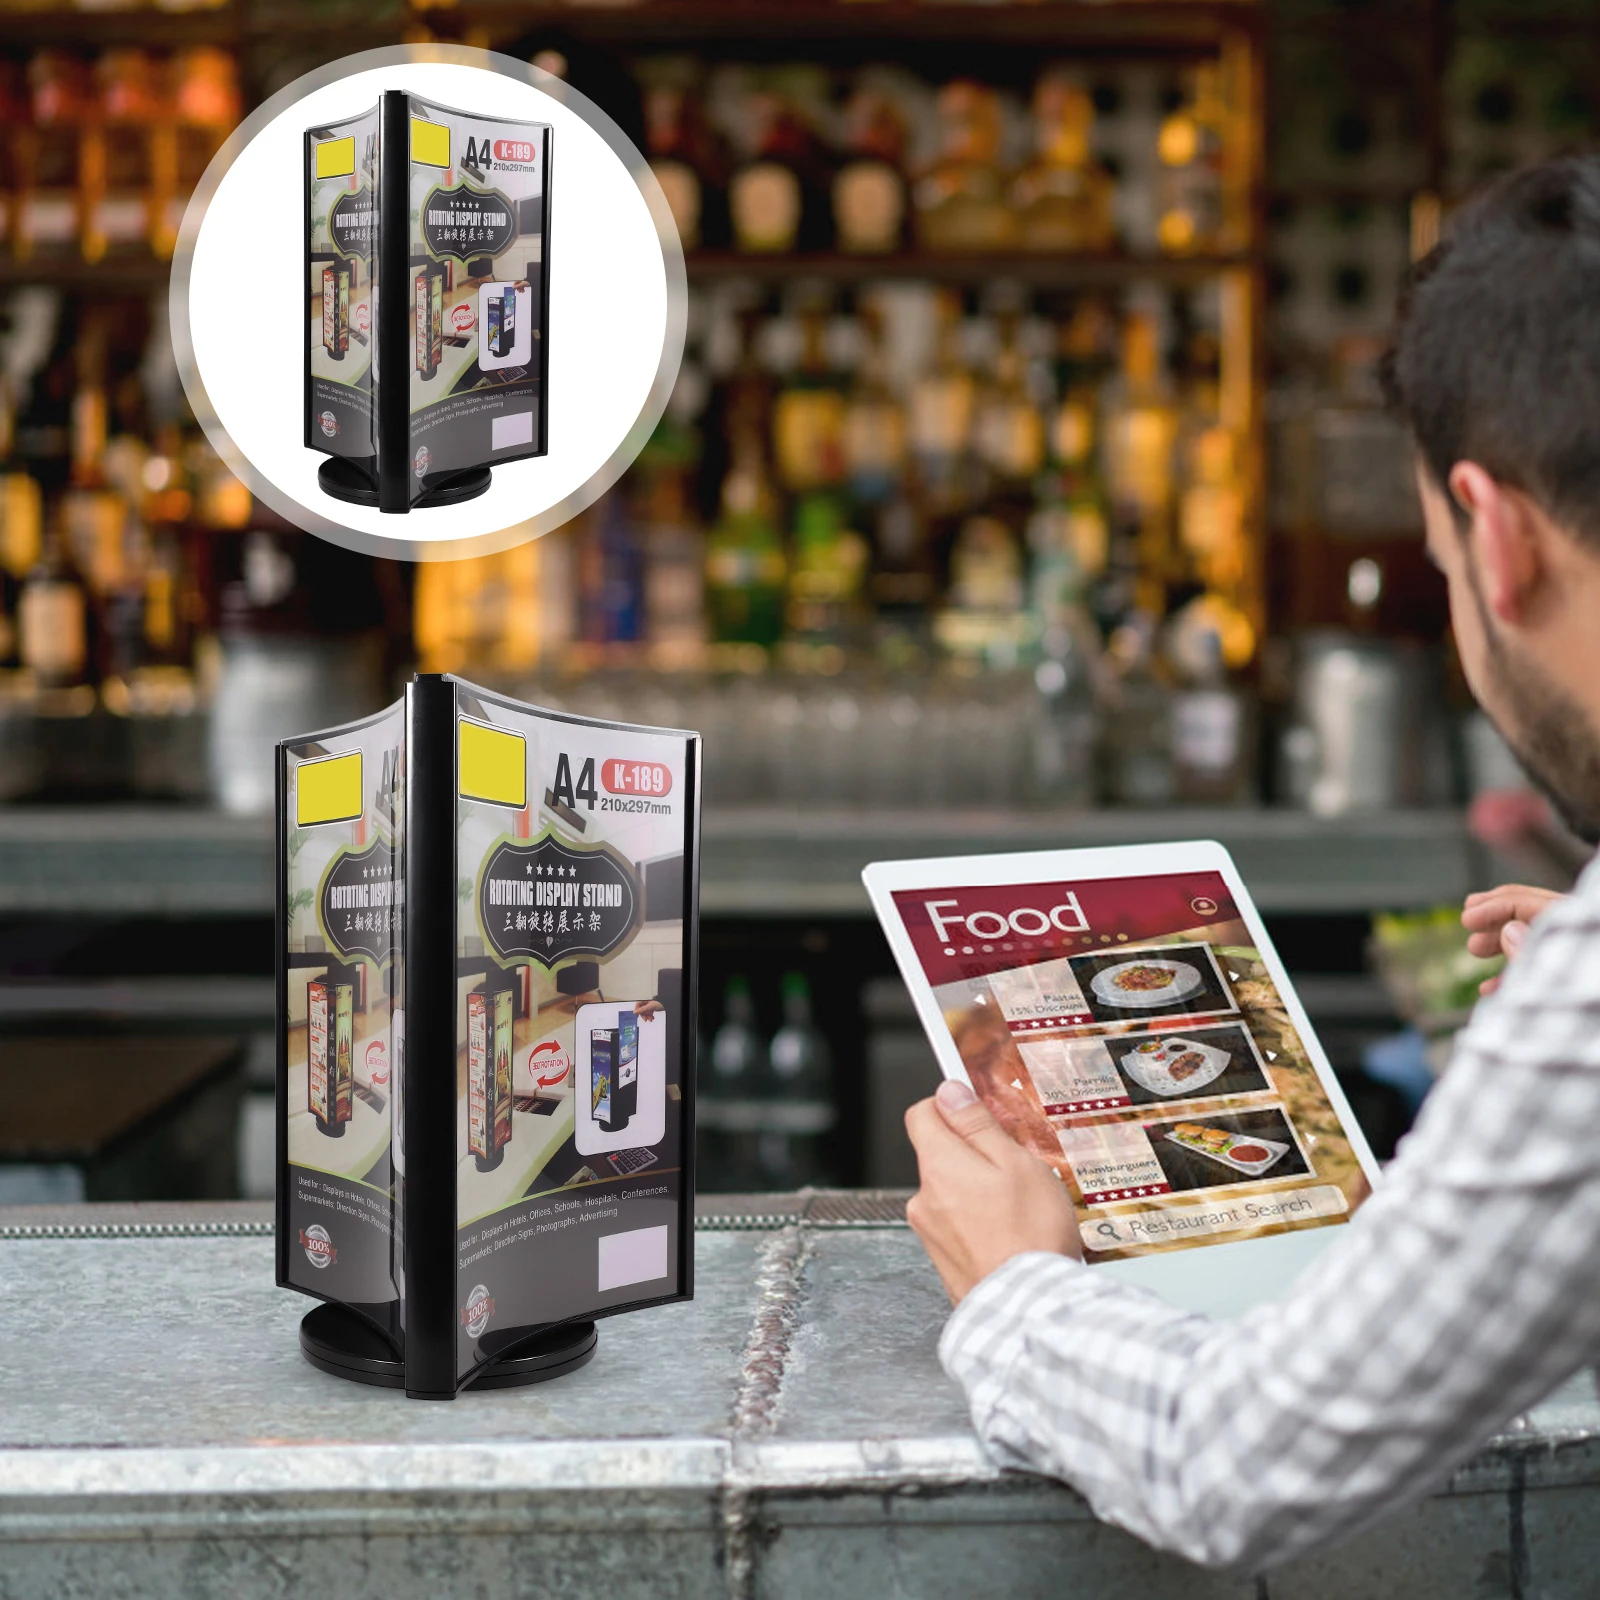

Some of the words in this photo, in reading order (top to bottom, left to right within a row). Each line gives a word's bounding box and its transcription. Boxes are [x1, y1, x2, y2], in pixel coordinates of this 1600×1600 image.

[466, 136, 492, 170] A4
[501, 142, 531, 160] K-189
[493, 162, 535, 173] 210x297mm
[428, 210, 455, 226] ROTATING
[456, 211, 482, 227] DISPLAY
[483, 212, 507, 227] STAND
[551, 752, 598, 810] A4
[614, 763, 664, 793] K-189
[600, 797, 672, 815] 210x297mm
[331, 884, 369, 909] ROTATING
[489, 878, 534, 906] ROTATING
[536, 881, 580, 907] DISPLAY
[582, 883, 623, 907] STAND
[924, 891, 1090, 943] Food
[1043, 994, 1081, 1002] Pastas
[1034, 1003, 1084, 1013] Discount
[1071, 1086, 1119, 1096] Discount
[1076, 1159, 1157, 1176] Hamburguers
[1109, 1172, 1161, 1185] Discount
[322, 1183, 344, 1199] Displays
[336, 1201, 358, 1216] Direction
[1128, 1208, 1241, 1237] Restaurant
[1244, 1195, 1313, 1219] Search
[459, 1235, 471, 1251] Used
[481, 1225, 503, 1241] Displays
[503, 1221, 509, 1230] in
[509, 1214, 529, 1228] Hotels,
[529, 1207, 553, 1220] Offices,
[554, 1200, 582, 1213] Schools,
[585, 1193, 620, 1207] Hospitals,
[621, 1186, 670, 1200] Conferences,
[494, 1234, 517, 1251] Direction
[517, 1228, 536, 1241] Signs,
[536, 1216, 578, 1234] Photographs,
[579, 1208, 618, 1223] Advertising
[308, 1239, 330, 1254] 100%
[468, 1298, 488, 1323] 100%
